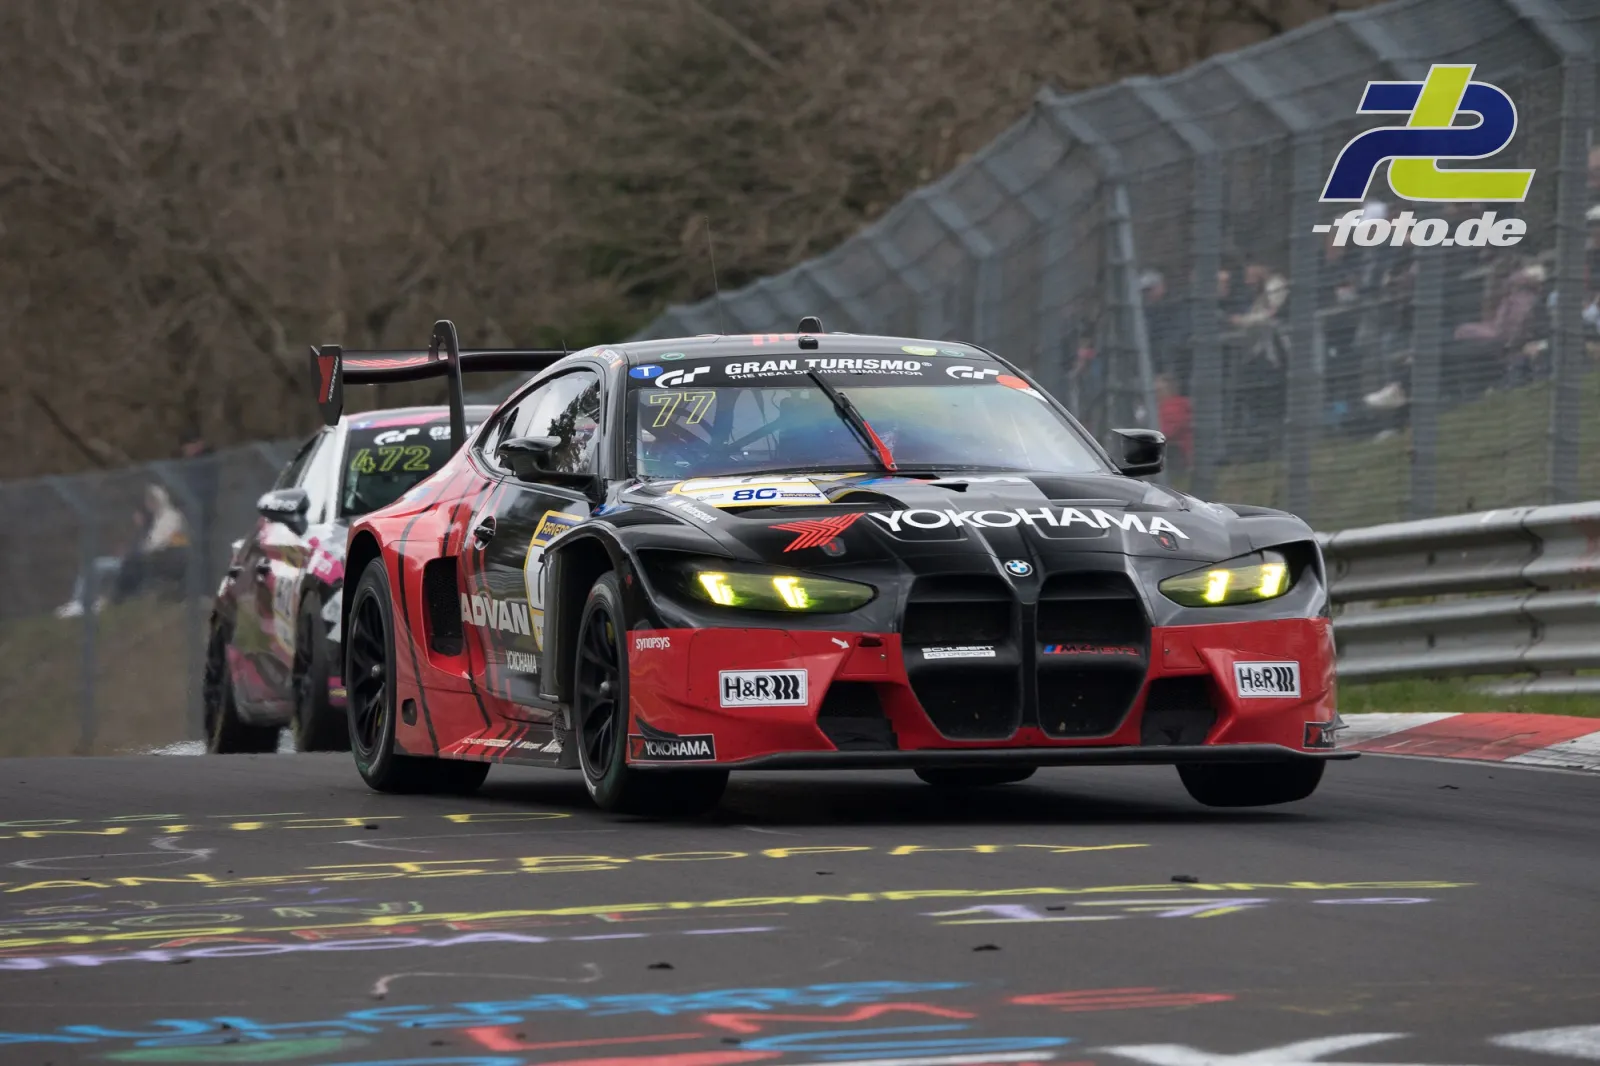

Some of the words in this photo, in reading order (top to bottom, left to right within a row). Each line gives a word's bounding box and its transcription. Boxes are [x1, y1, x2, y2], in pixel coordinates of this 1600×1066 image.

[725, 359, 797, 375] GRAN
[849, 369, 923, 377] SIMULATOR
[650, 391, 716, 427] 77
[351, 445, 431, 473] 472
[868, 507, 1191, 540] YOKOHAMA
[461, 592, 530, 636] ADVAN
[921, 645, 994, 653] SCHUBERT
[925, 650, 996, 659] MOTORSPORT
[505, 649, 538, 675] YOKOHAMA
[645, 740, 711, 756] YOKOHAMA
